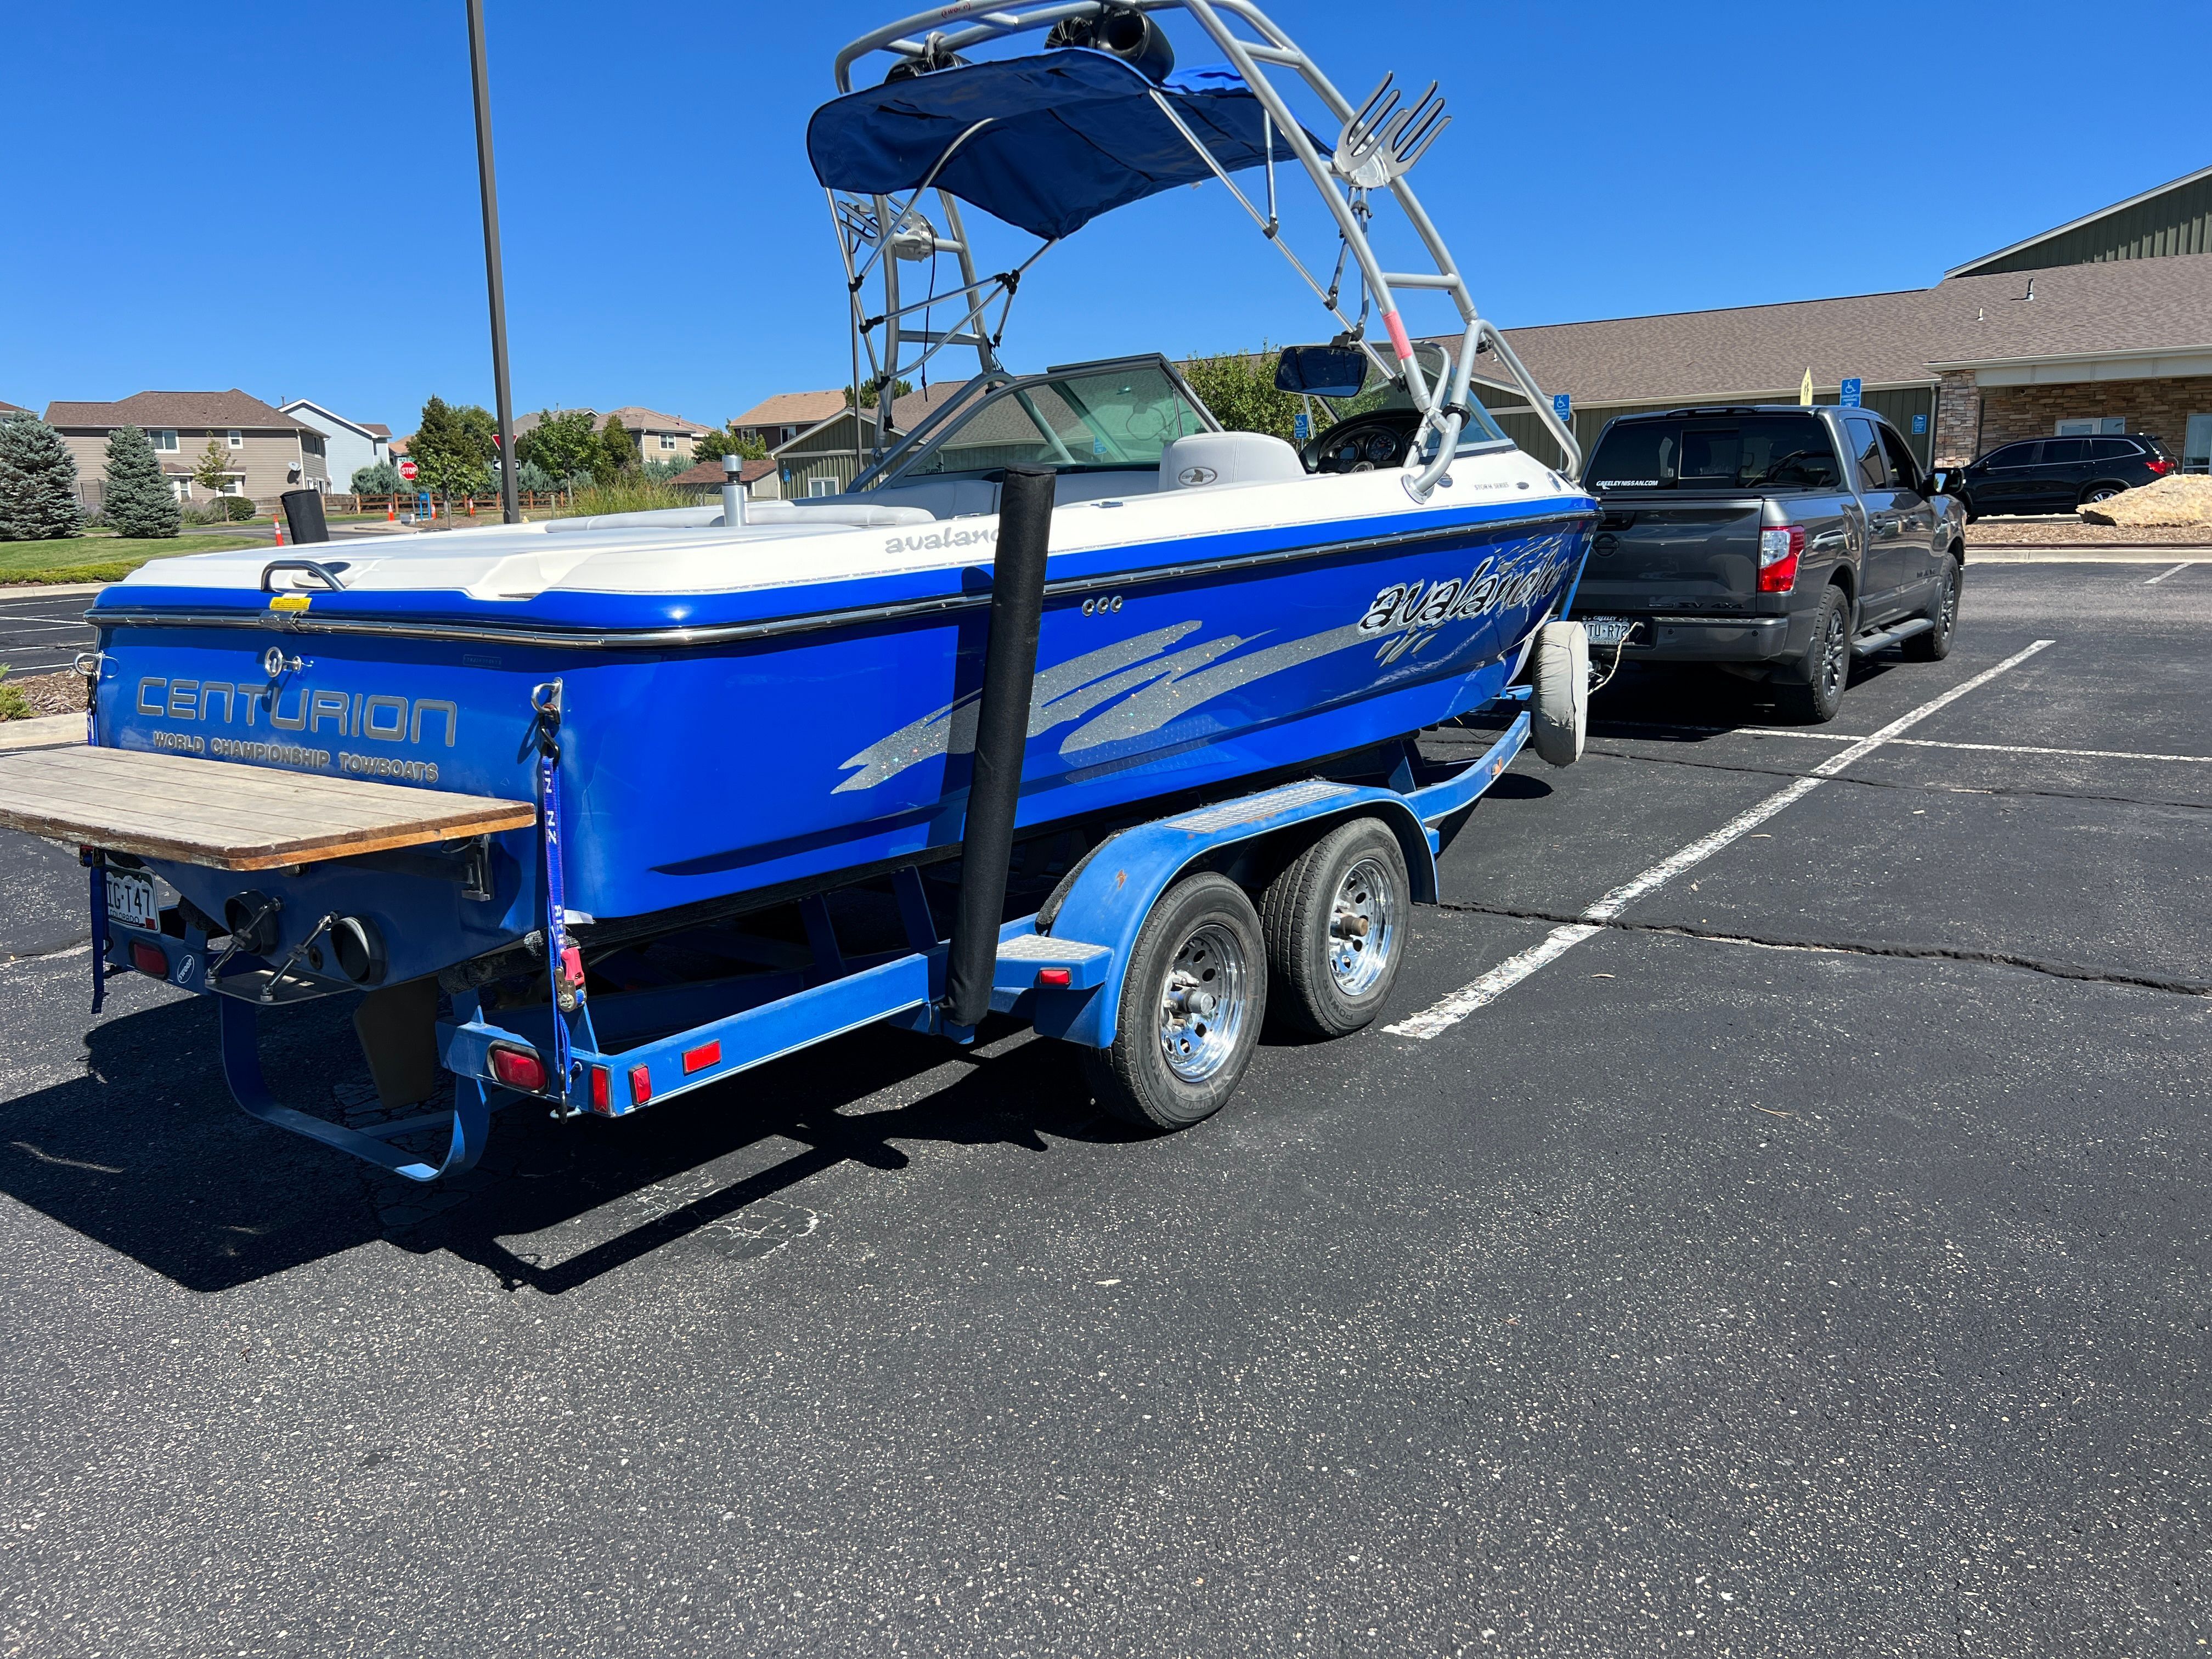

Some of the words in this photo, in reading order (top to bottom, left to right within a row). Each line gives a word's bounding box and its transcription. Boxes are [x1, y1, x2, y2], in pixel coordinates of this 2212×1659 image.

[402, 467, 417, 475] STOP
[1596, 480, 1658, 489] GREELEYNISSAN.COM
[885, 527, 999, 554] avalanc
[136, 677, 457, 747] CENTURION
[154, 731, 204, 752] WORLD
[211, 737, 330, 768] CHAMPIONSHIP
[338, 752, 438, 783] TOWBOATS
[109, 909, 140, 923] COLORADO
